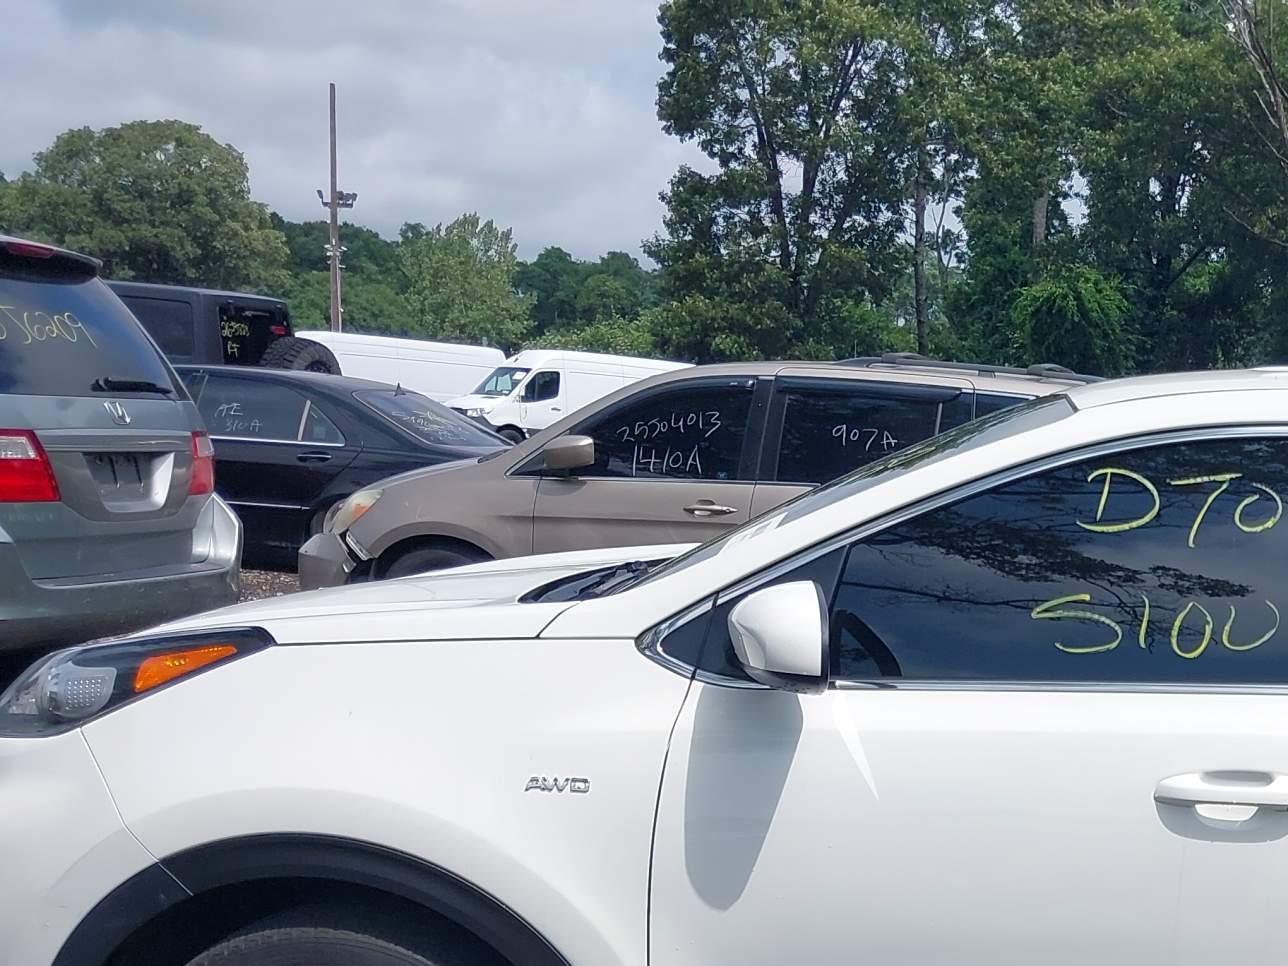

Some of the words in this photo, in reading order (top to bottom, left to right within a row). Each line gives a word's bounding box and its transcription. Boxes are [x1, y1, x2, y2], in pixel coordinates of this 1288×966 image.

[832, 424, 898, 452] 907A
[632, 443, 702, 477] 1410A
[1076, 468, 1284, 548] D70
[524, 776, 590, 793] AWD
